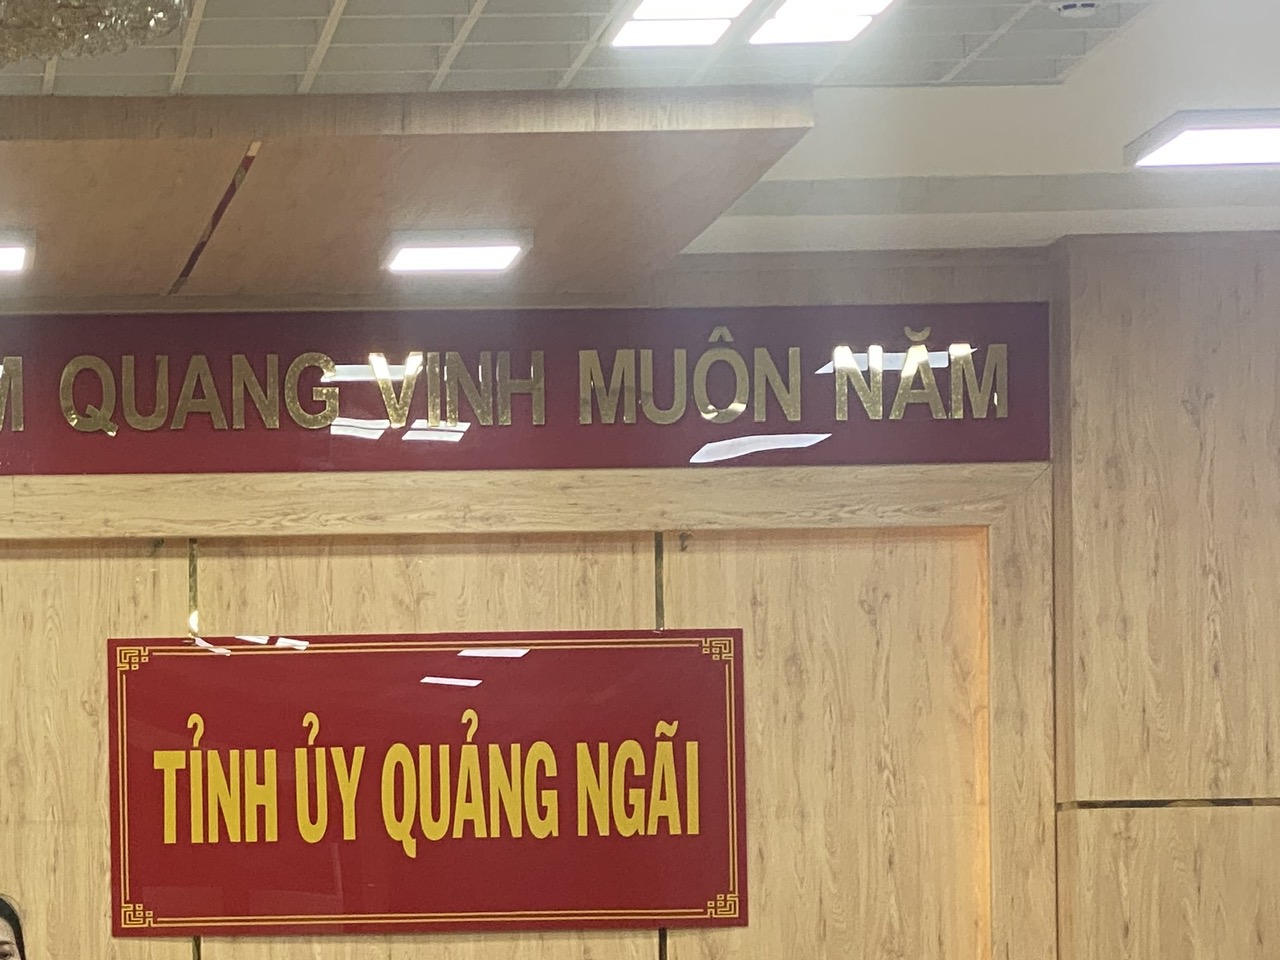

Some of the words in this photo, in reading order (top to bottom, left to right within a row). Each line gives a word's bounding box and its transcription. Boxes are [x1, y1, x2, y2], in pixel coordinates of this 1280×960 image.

[59, 352, 339, 436] QUANG
[369, 352, 545, 429] VINH
[578, 328, 802, 426] MUÔN
[833, 328, 1010, 421] NĂM
[153, 713, 279, 844] TỈNH
[295, 711, 366, 842] ỦY
[381, 709, 559, 858] QUẢNG
[577, 720, 700, 838] NGÃI
